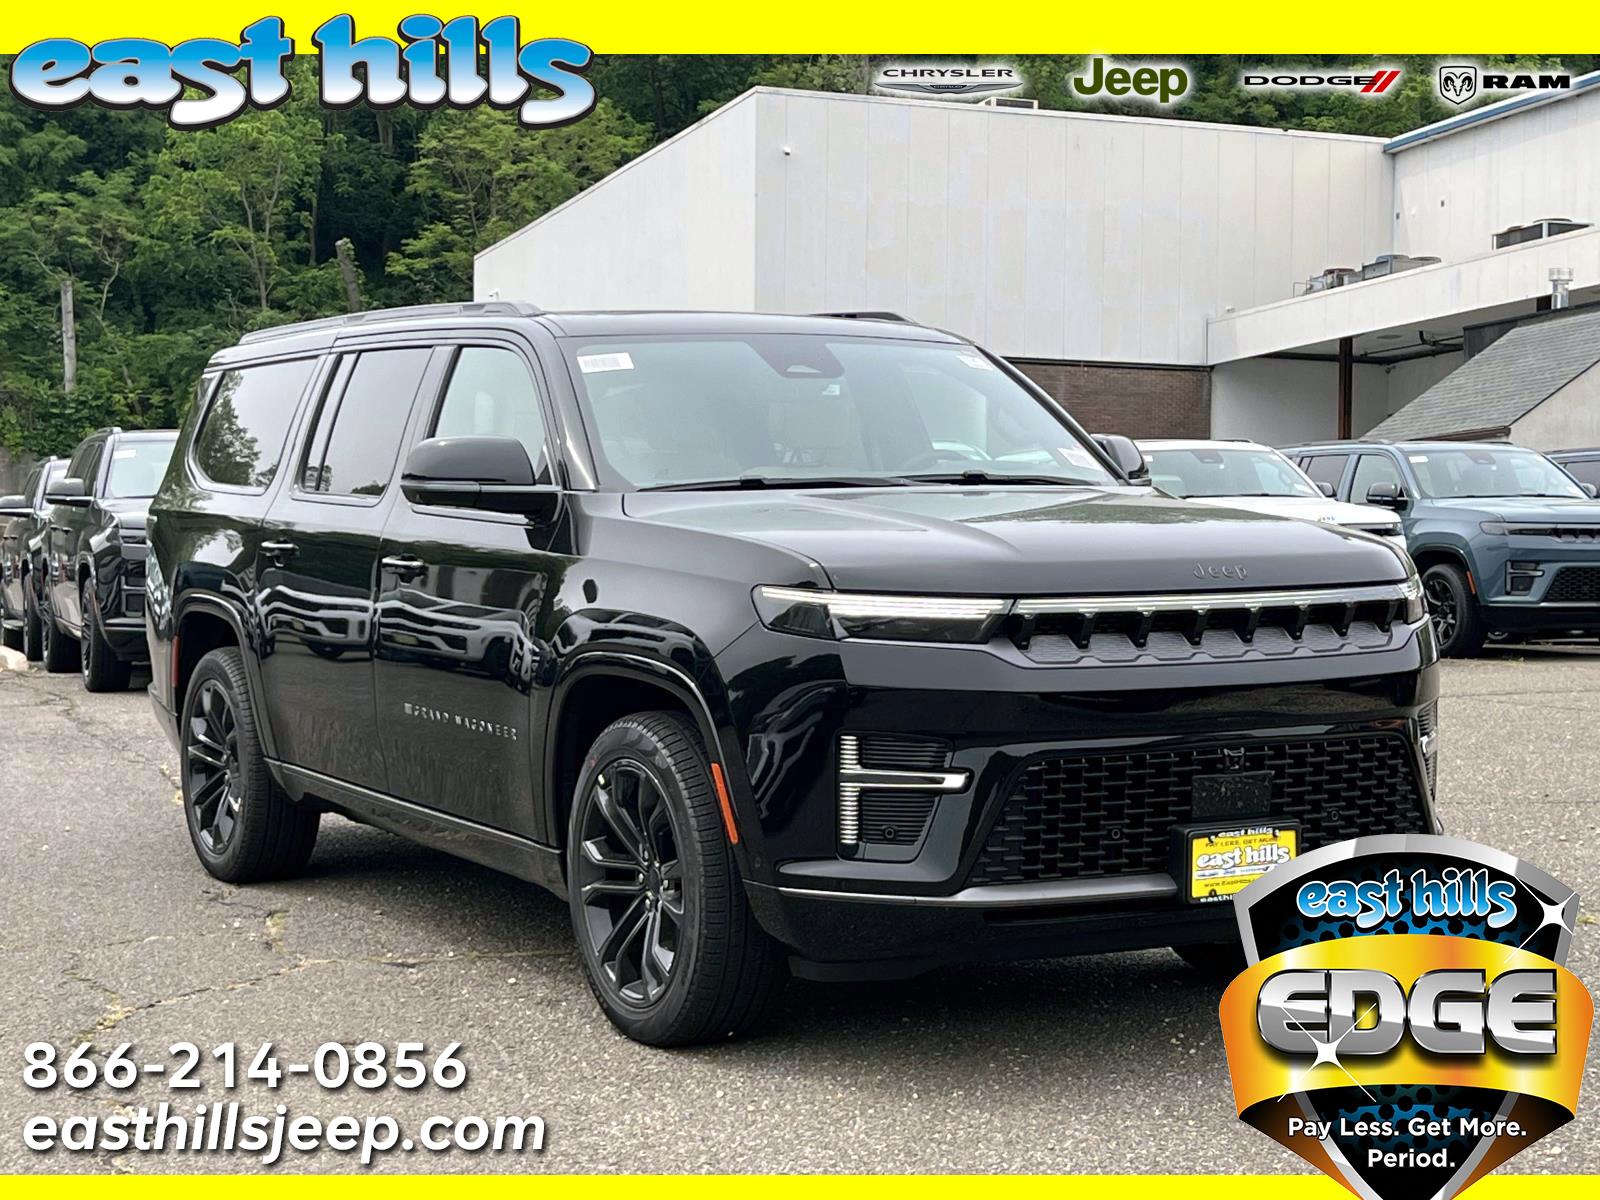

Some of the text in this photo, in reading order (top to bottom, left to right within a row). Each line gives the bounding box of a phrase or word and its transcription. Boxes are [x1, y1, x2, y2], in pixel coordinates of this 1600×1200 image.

[1193, 562, 1248, 581] Jeep
[1196, 843, 1291, 869] east hills
